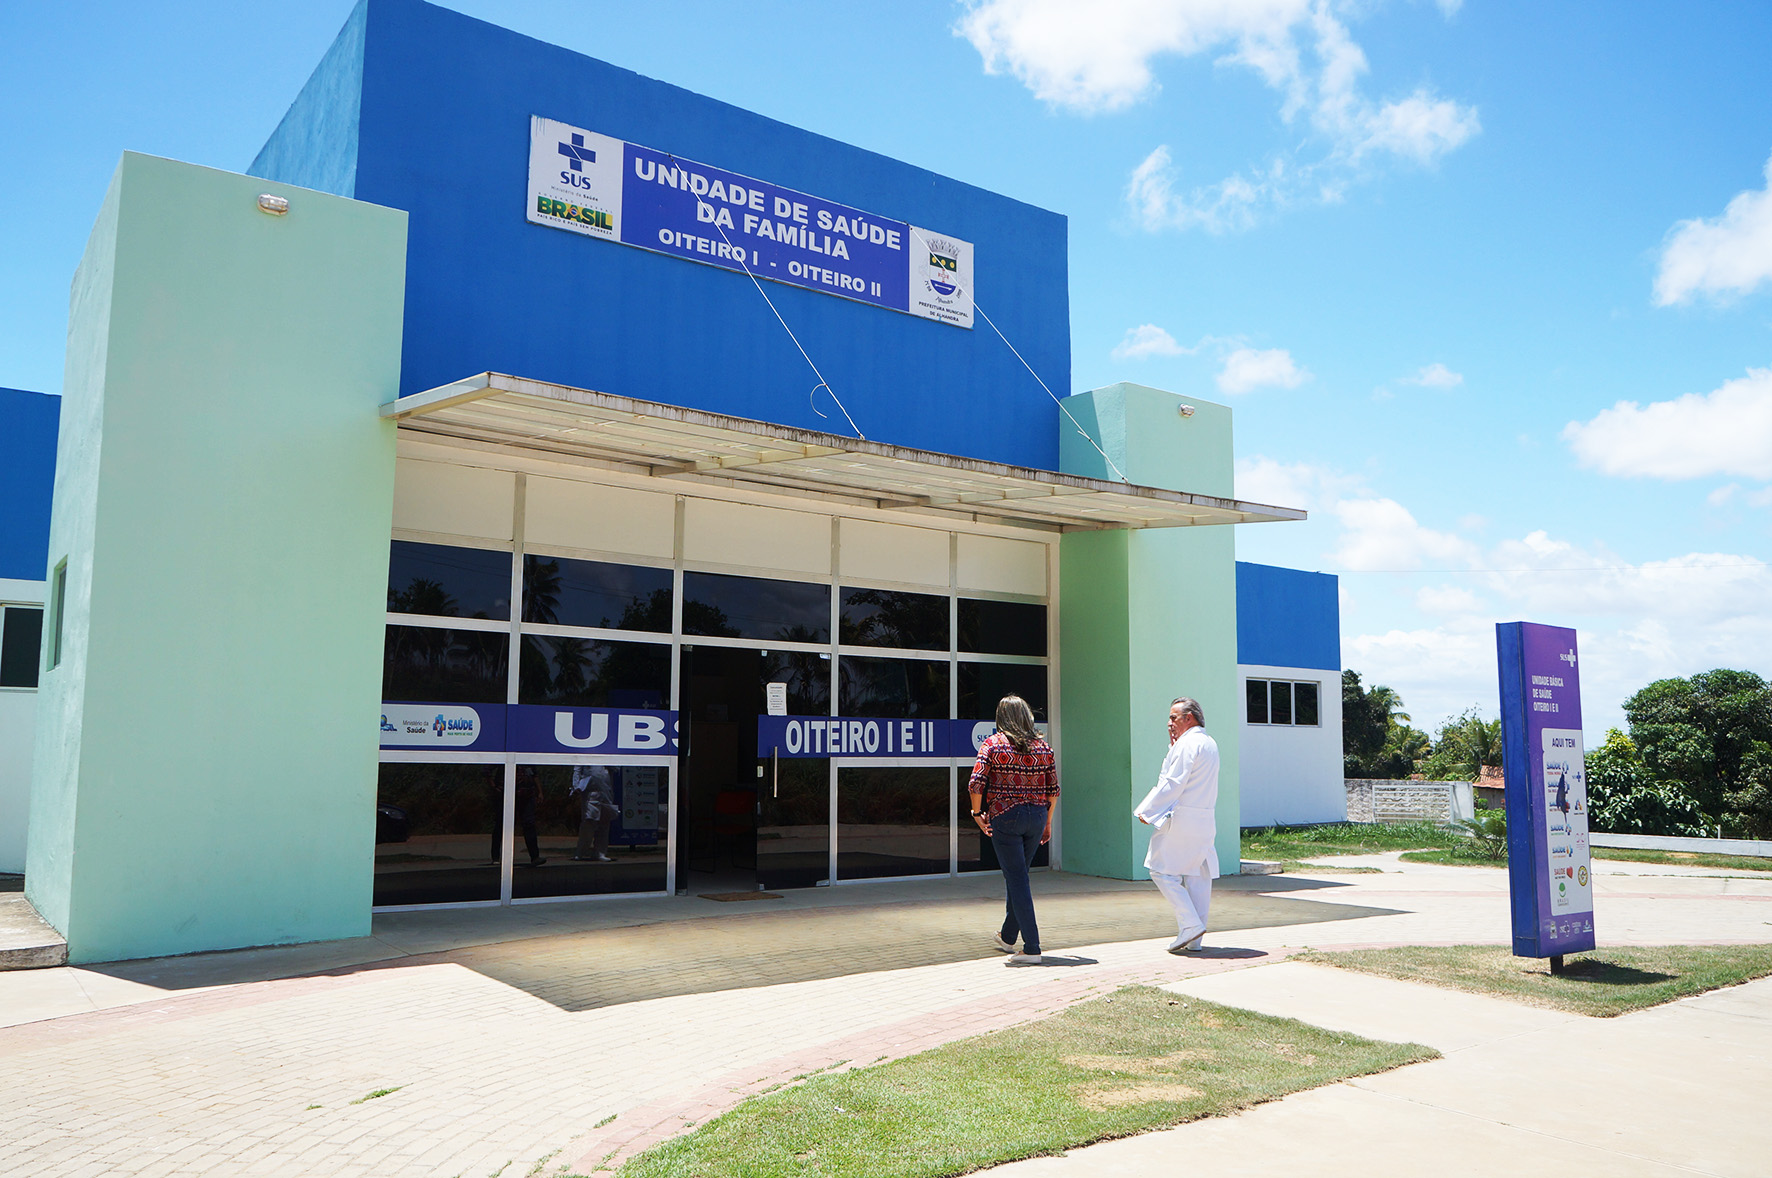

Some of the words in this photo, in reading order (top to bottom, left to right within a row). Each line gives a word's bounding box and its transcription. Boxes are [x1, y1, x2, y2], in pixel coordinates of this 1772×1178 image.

[560, 171, 591, 190] SUS
[537, 196, 613, 230] BRASIL
[635, 157, 765, 212] UNIDADE
[774, 196, 809, 225] DE
[817, 217, 901, 250] SAÚDE
[696, 202, 735, 230] DA
[743, 213, 850, 260] FAMÍLIA
[658, 228, 747, 262] OITEIRO
[752, 251, 758, 266] I
[788, 261, 866, 293] OITEIRO
[870, 282, 881, 297] II
[1531, 675, 1549, 686] UNIDADE
[1549, 675, 1564, 687] BÁSICA
[1532, 688, 1538, 698] DE
[1539, 687, 1552, 699] SAÚDE
[1533, 702, 1549, 712] OITEIRO
[447, 717, 473, 731] SAÚDE
[554, 711, 678, 749] UB
[785, 720, 880, 754] OITEIRO
[887, 721, 893, 753] I
[901, 721, 914, 752] E
[921, 721, 934, 752] II
[1552, 738, 1564, 748] AQUI
[1565, 739, 1575, 747] TEM
